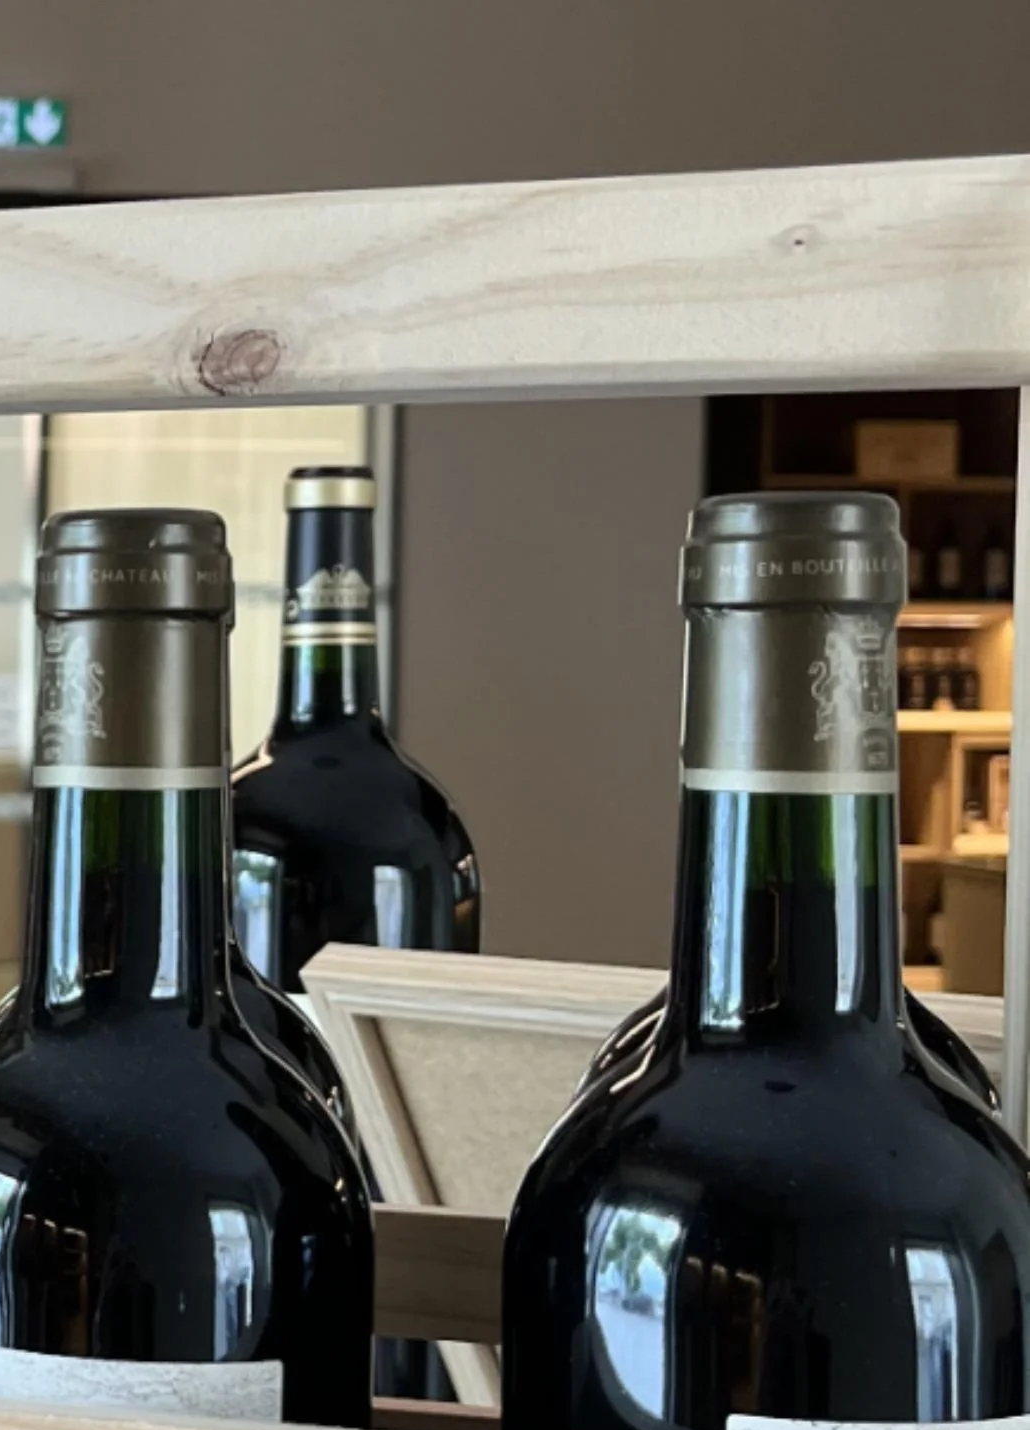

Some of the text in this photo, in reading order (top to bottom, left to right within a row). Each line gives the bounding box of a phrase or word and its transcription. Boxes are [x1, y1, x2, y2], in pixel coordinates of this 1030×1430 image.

[756, 561, 784, 577] EN
[792, 557, 889, 576] BOUTILLE
[89, 568, 175, 585] CHATEAU
